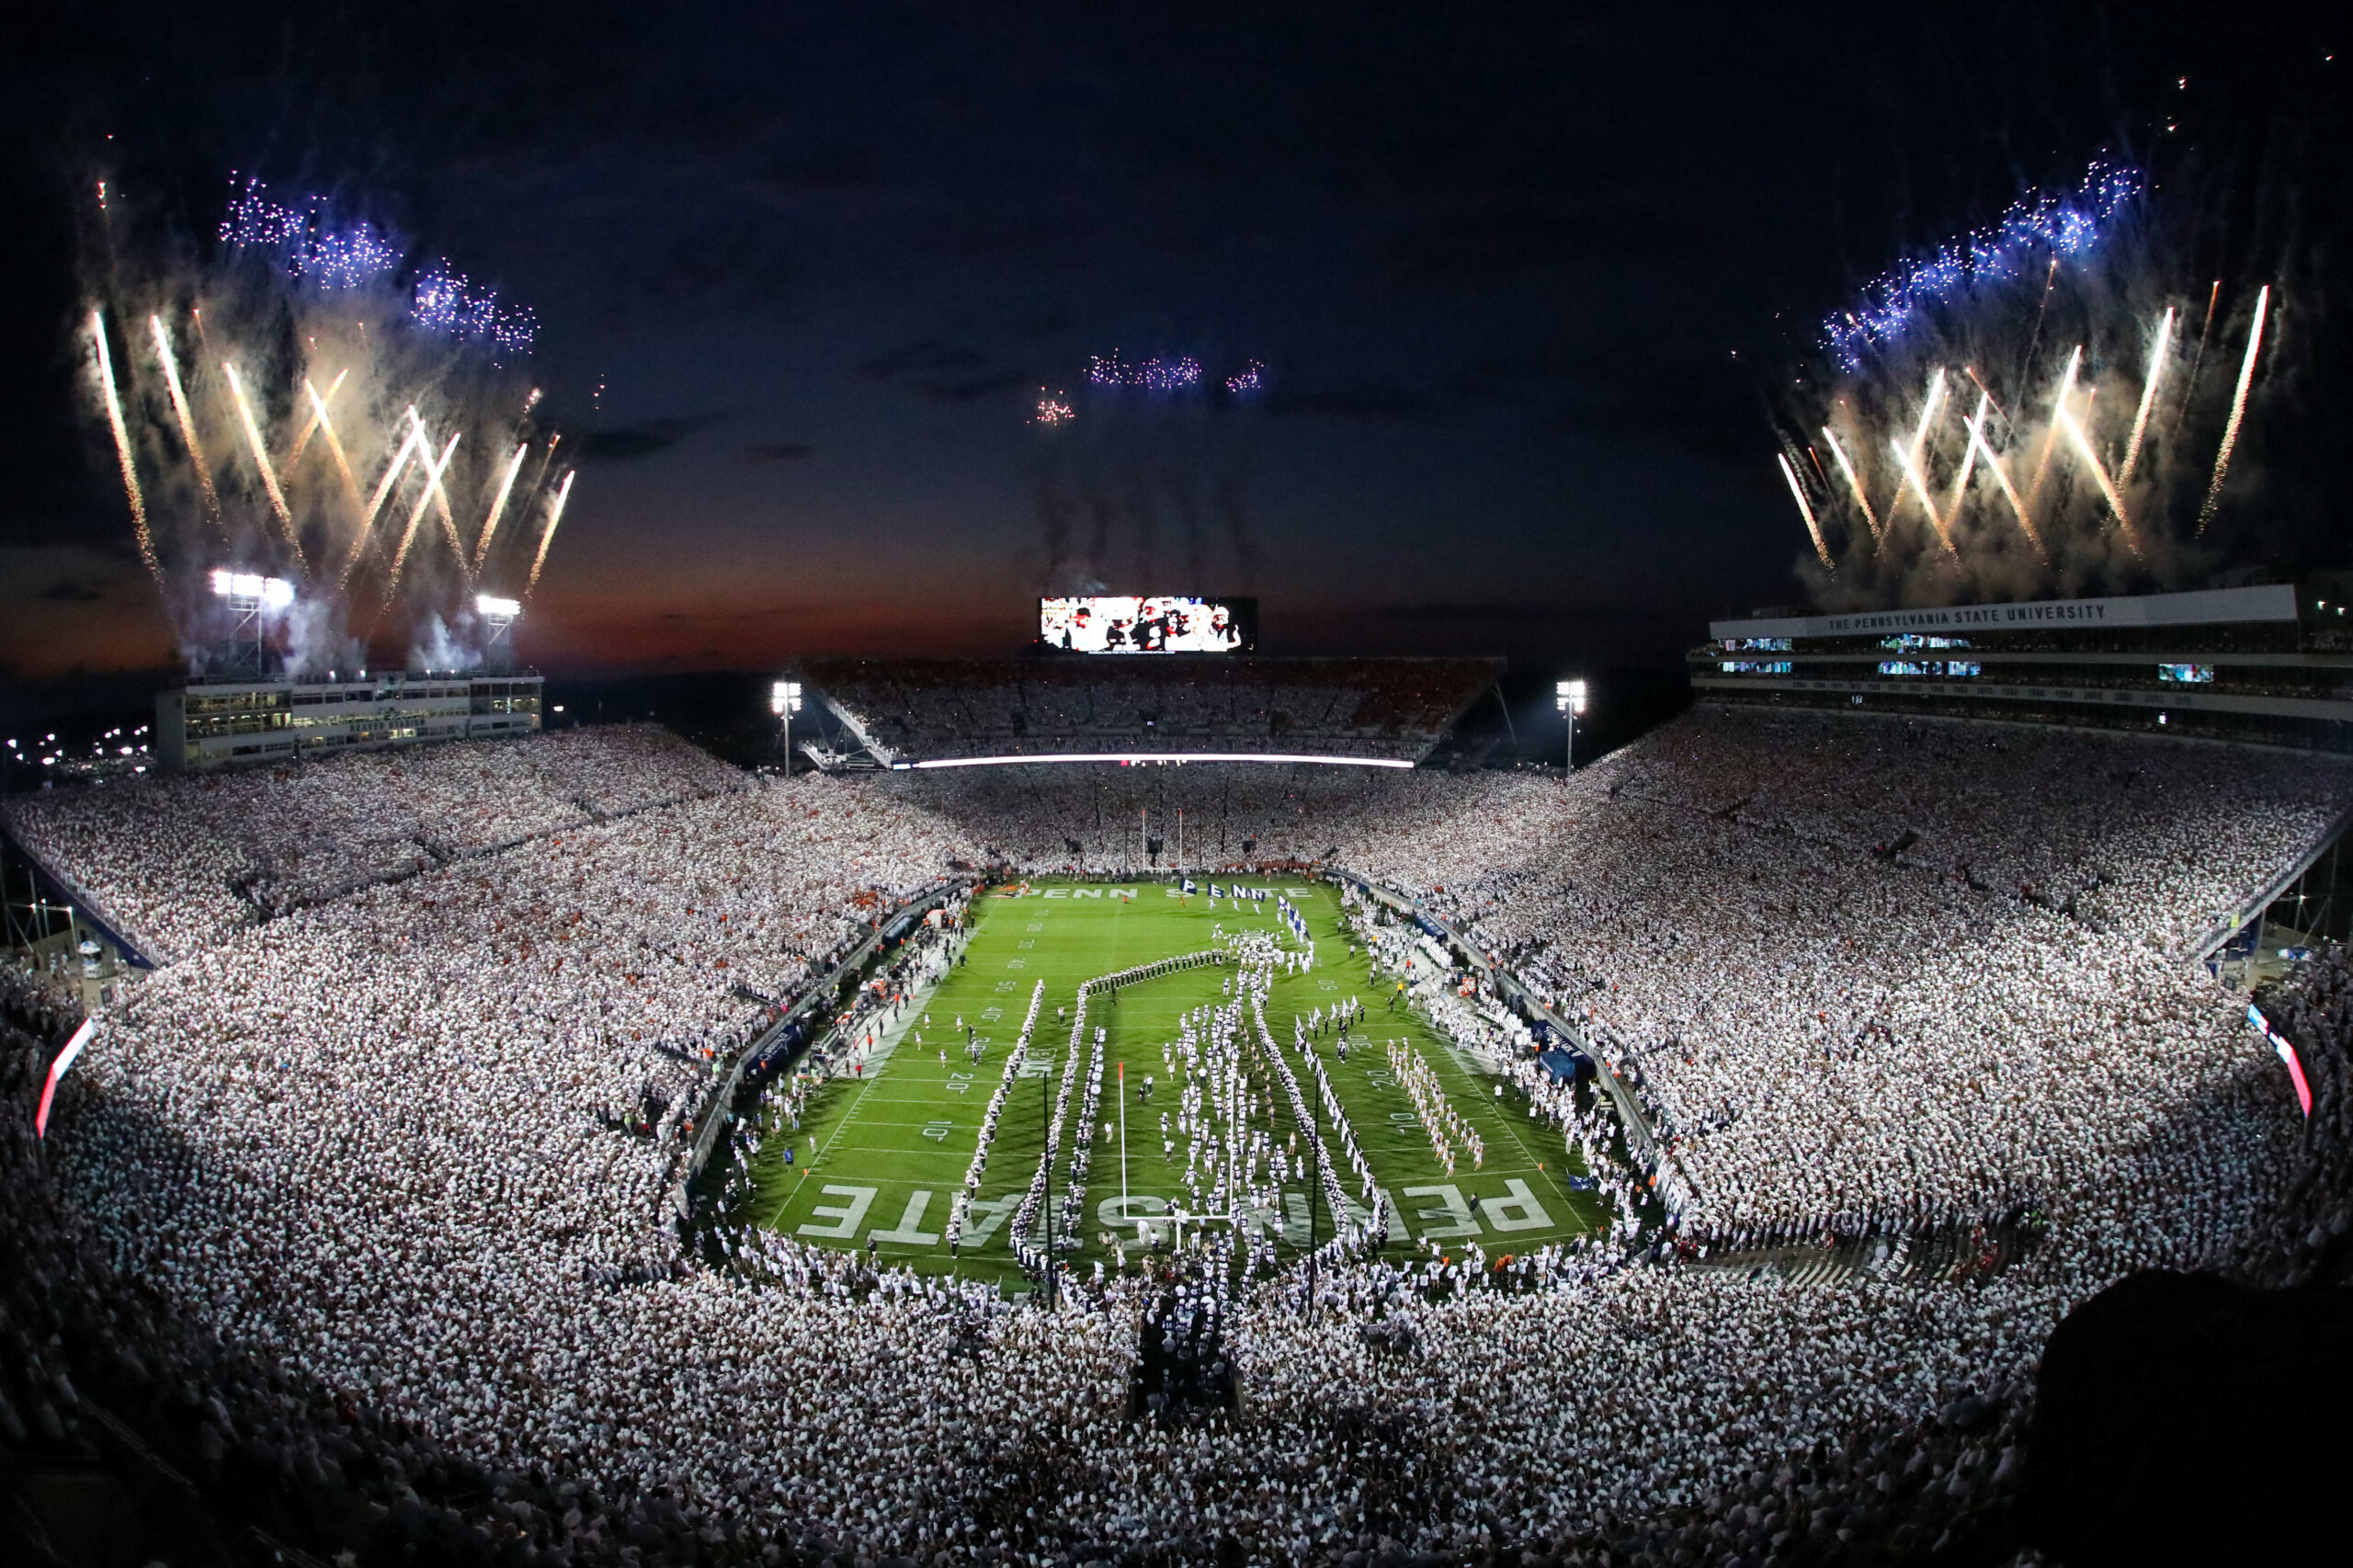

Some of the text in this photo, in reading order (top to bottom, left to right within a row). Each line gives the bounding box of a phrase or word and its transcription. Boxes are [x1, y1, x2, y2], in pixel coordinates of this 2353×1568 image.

[1829, 605, 2105, 630] THE PENNSYLVANIA STATE UNIVERSITY
[350, 722, 384, 733] BEAVER
[1317, 980, 1338, 991] 50
[982, 1007, 1002, 1020] 40
[1347, 1034, 1372, 1052] 30
[946, 1073, 973, 1091] 20
[1367, 1070, 1396, 1088] 20
[922, 1120, 952, 1137] 10
[1390, 1112, 1425, 1128] 10
[796, 1178, 1555, 1249] PENN STATE
